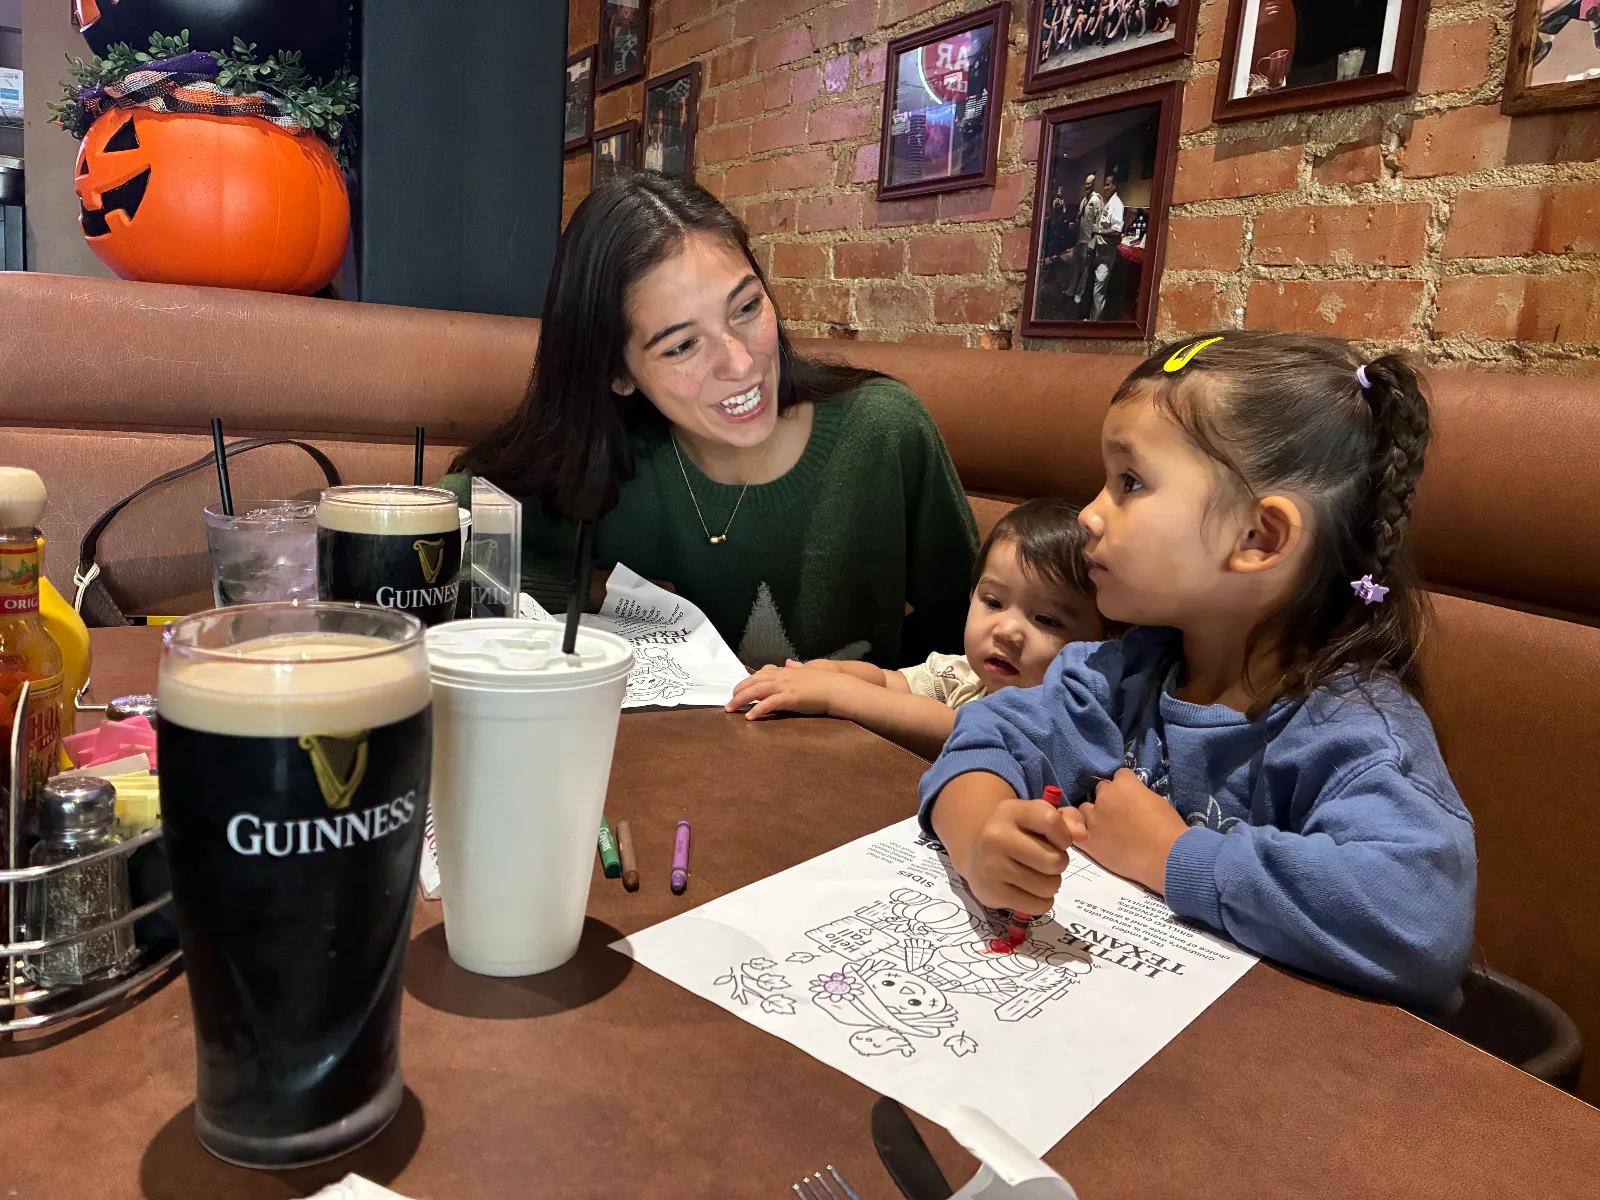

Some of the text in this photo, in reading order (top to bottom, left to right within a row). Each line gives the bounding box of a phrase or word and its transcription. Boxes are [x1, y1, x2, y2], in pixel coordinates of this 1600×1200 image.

[376, 580, 460, 609] GUINNES
[227, 789, 416, 858] GUINNESS
[896, 870, 935, 888] SIDES
[1083, 908, 1102, 918] with
[1117, 906, 1194, 938] GRILLED CHEESE
[1101, 915, 1132, 930] served
[1130, 918, 1148, 928] and
[1148, 927, 1168, 936] side
[825, 933, 860, 953] Hello
[837, 928, 873, 947] Fall
[1141, 930, 1168, 944] menu
[1168, 934, 1186, 944] one
[1186, 941, 1198, 949] of
[1057, 932, 1163, 979] LITTLE
[1064, 923, 1186, 976] TEXANS
[1168, 941, 1215, 961] Children's
[1198, 946, 1230, 960] choice
